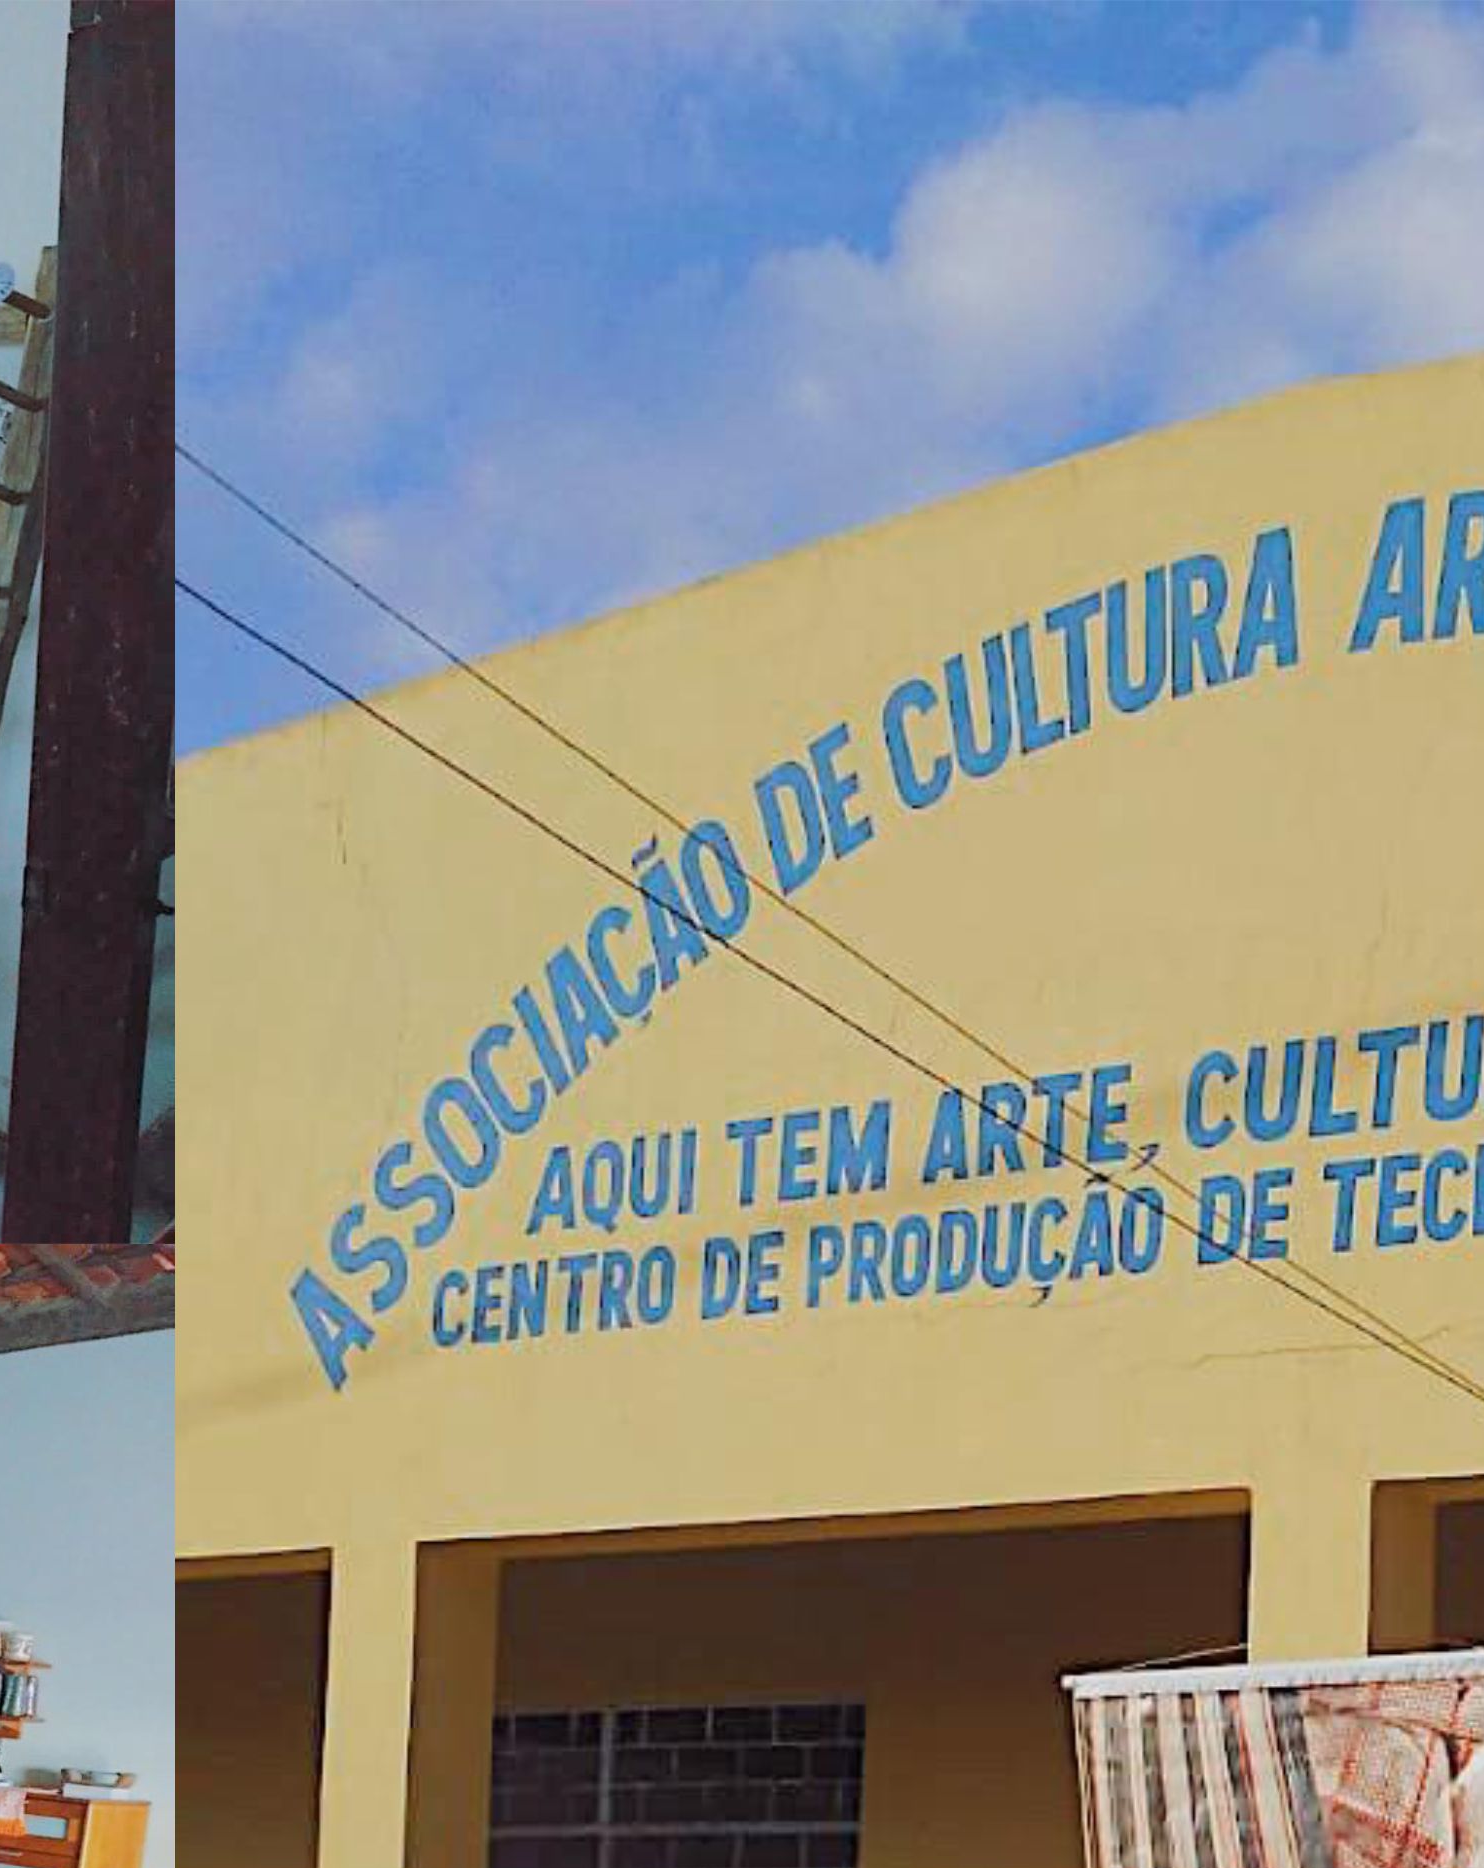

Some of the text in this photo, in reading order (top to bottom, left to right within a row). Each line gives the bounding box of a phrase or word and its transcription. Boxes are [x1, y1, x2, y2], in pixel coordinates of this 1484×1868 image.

[289, 818, 753, 1392] ASSOCIAÇÃO
[753, 722, 874, 894] DE
[883, 527, 1299, 810] CULTURA
[525, 1130, 698, 1235] AQUI
[726, 1100, 892, 1206] TEM
[921, 1064, 1162, 1182] ARTE,
[431, 1250, 677, 1347] CENTRO
[701, 1230, 783, 1320] DE
[806, 1174, 1165, 1309] PRODUÇÃO
[1196, 1166, 1293, 1265] DE
